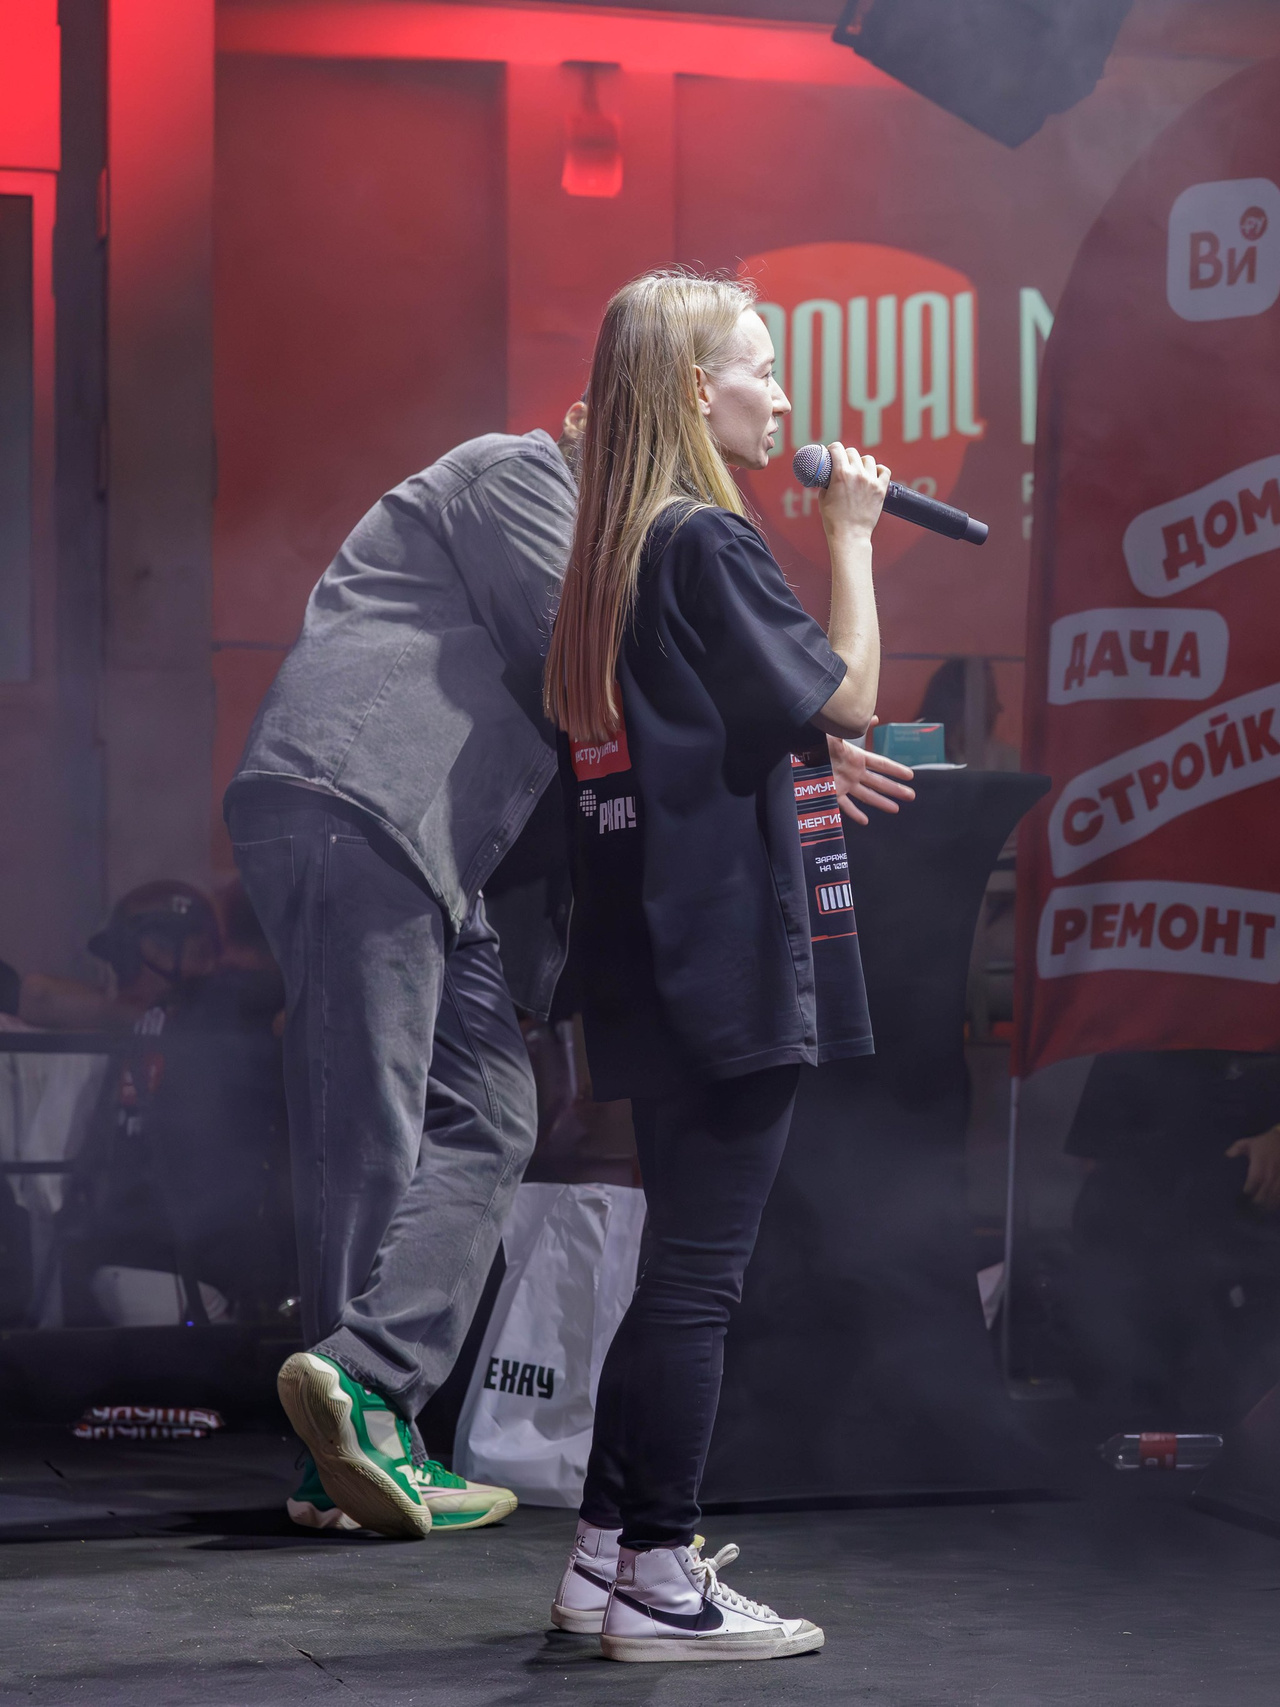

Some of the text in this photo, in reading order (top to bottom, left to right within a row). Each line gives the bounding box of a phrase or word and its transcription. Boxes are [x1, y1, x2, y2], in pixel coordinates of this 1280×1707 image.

[1189, 230, 1257, 291] Ви
[1063, 630, 1201, 692] ДАЧА
[794, 781, 836, 798] ОММУН
[599, 796, 637, 834] РХАУ
[798, 813, 842, 830] НЕРГИ
[1050, 902, 1276, 960] РЕМОНТ
[483, 1357, 555, 1400] ЕХАУ
